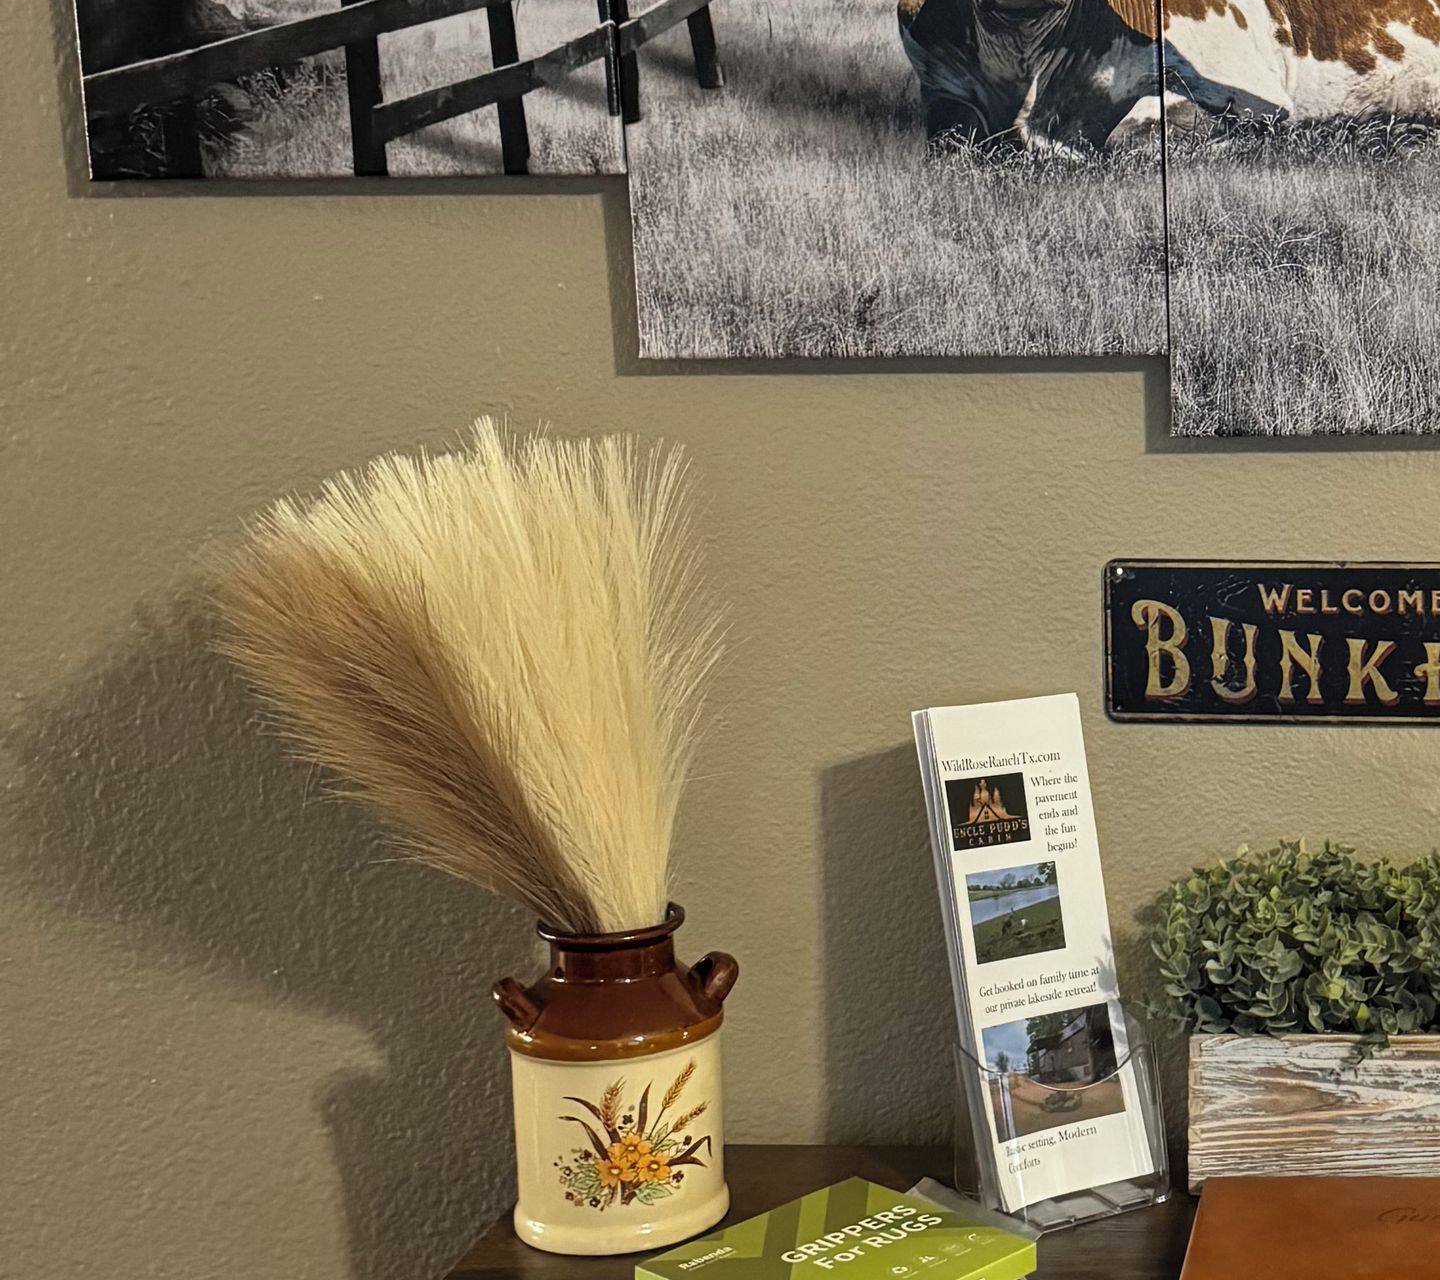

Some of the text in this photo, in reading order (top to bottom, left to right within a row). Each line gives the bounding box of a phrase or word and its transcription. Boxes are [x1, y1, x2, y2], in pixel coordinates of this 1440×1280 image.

[941, 751, 1061, 772] WildRoseRanchTx.com
[1030, 773, 1079, 787] Where the
[1035, 790, 1078, 806] pavement
[1038, 805, 1079, 820] ends and
[953, 819, 1028, 839] UNCLE PUDD'S
[1044, 822, 1077, 836] the fun
[968, 834, 1012, 847] CABIN
[1046, 838, 1078, 853] begins!
[979, 985, 993, 998] Get
[1026, 978, 1038, 988] on
[1039, 971, 1067, 986] family
[1068, 967, 1089, 980] time
[1091, 966, 1100, 976] at
[985, 981, 1097, 1014] our private lakeside retreat!
[1058, 1126, 1098, 1143] Modern
[780, 1204, 918, 1264] GRIPPERS
[813, 1245, 866, 1270] For
[861, 1213, 943, 1249] RUGS
[678, 1246, 734, 1270] Rabenda
